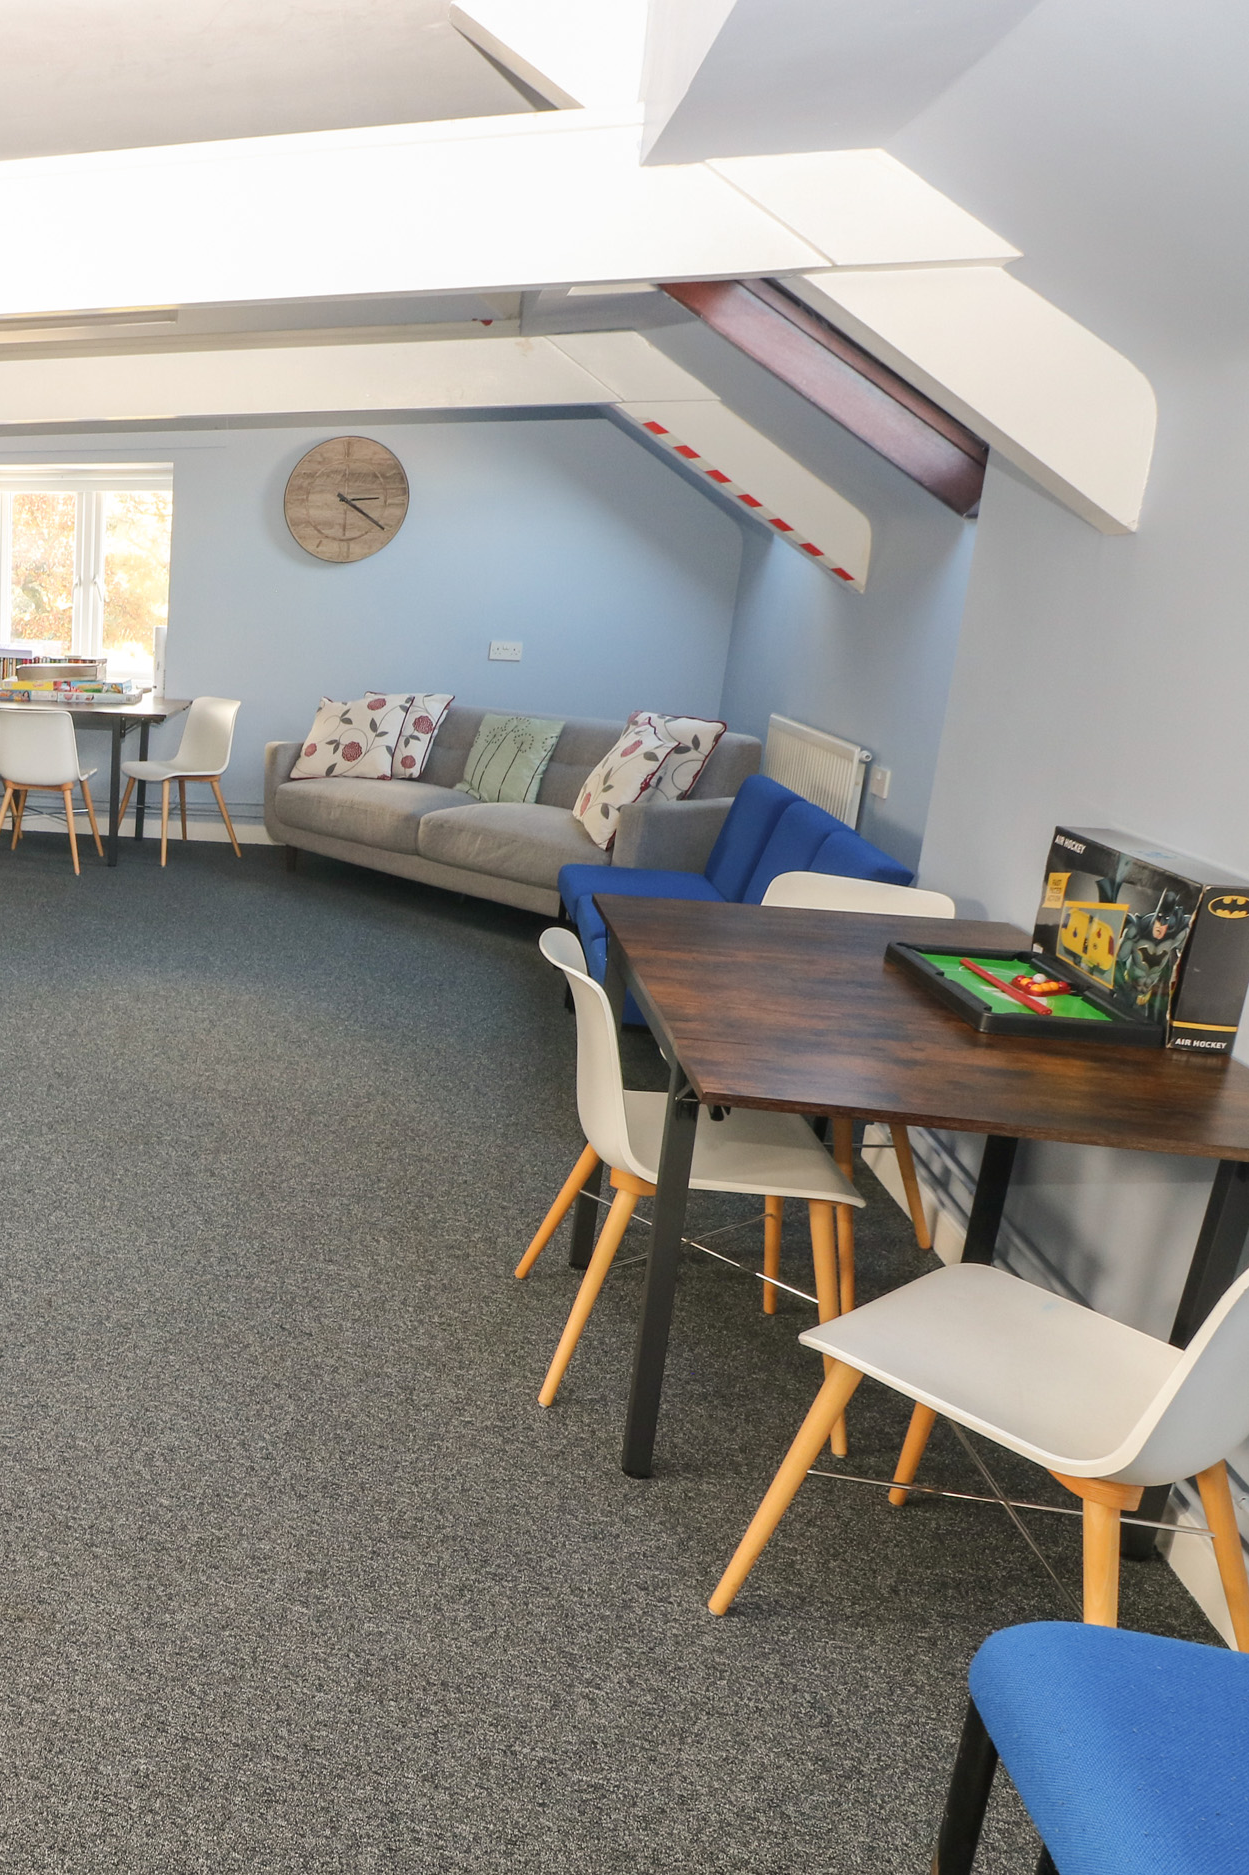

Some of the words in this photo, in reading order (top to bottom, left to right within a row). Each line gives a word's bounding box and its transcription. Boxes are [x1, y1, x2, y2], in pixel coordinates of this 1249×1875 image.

[1054, 834, 1065, 845] AIR
[1064, 838, 1086, 854] HOCKEY
[1175, 1038, 1192, 1046] AIR
[1192, 1040, 1227, 1049] HOCKEY
